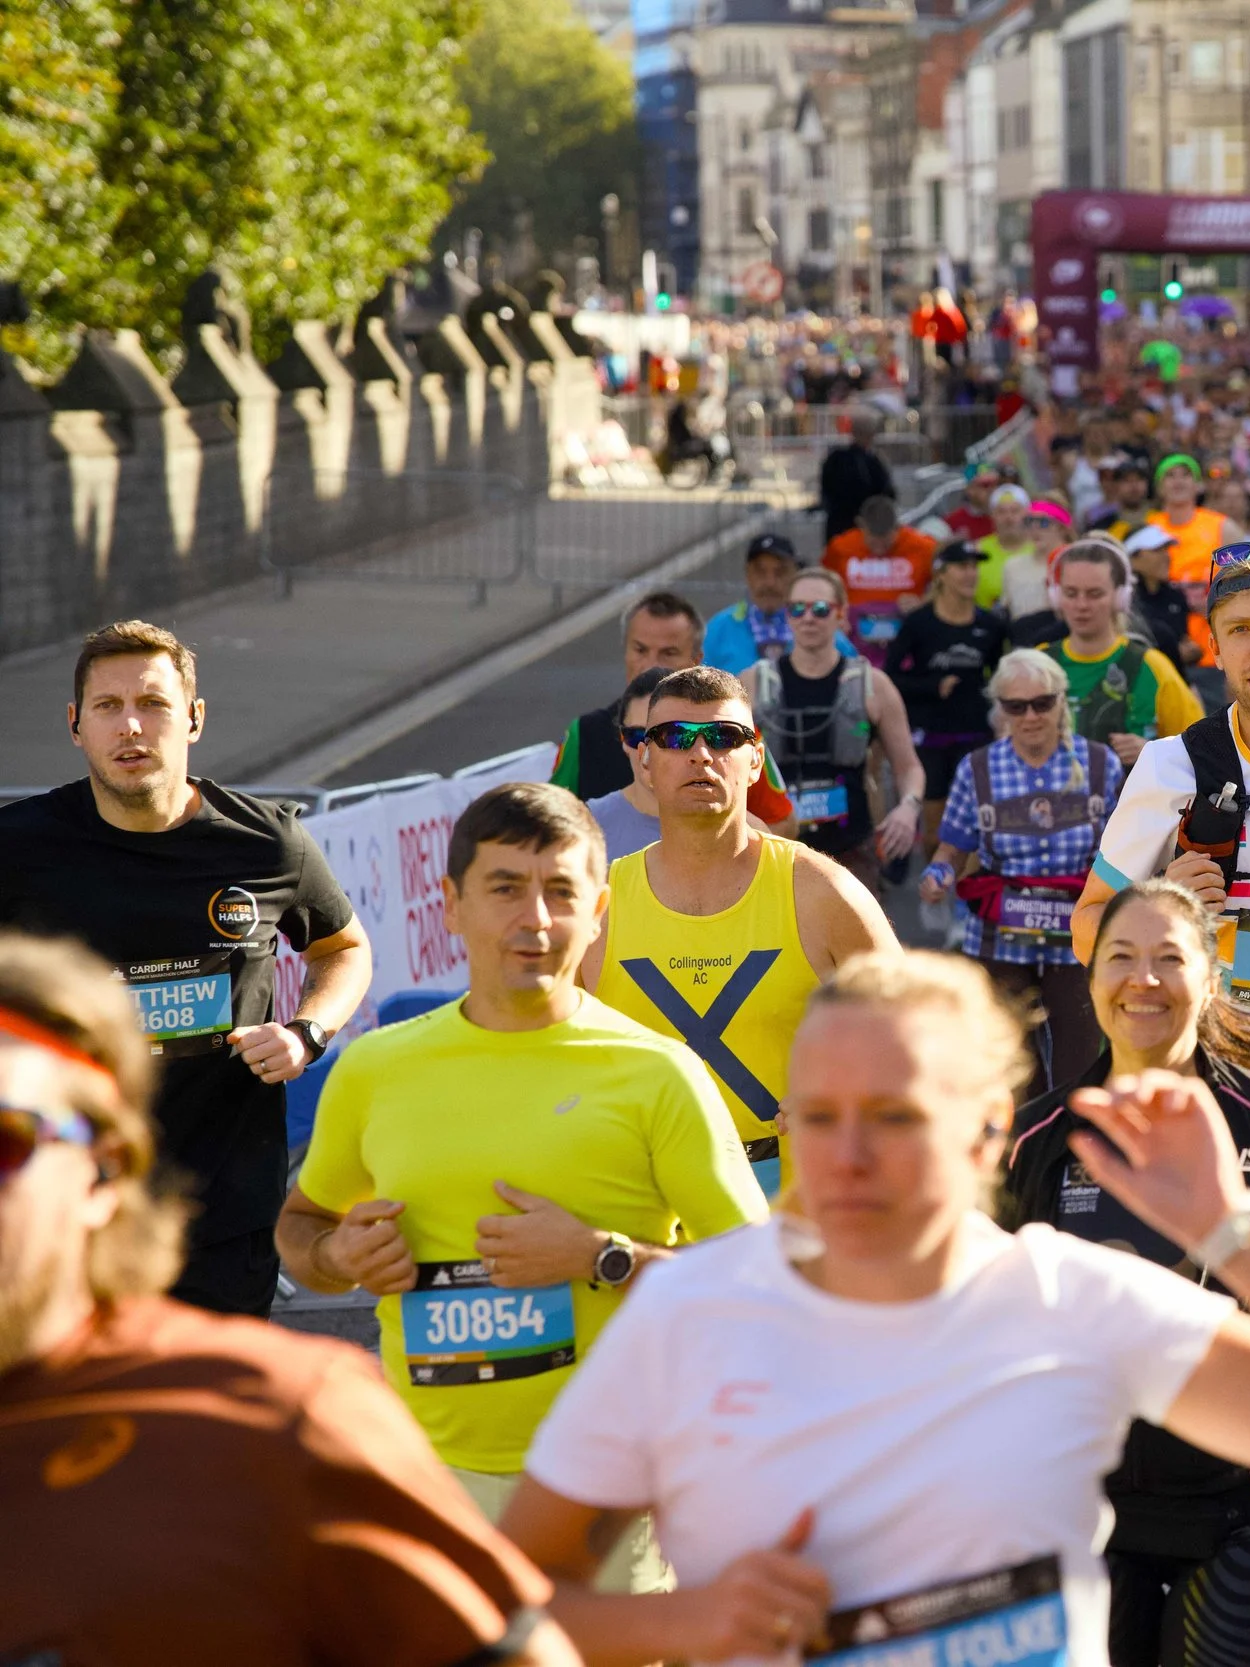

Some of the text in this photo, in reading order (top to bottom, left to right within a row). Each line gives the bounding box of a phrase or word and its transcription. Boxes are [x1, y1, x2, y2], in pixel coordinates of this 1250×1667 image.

[219, 903, 251, 913] SUPER
[218, 913, 253, 921] HALFS
[1024, 914, 1061, 929] 6724
[130, 959, 200, 975] CARDIFF HALF
[669, 954, 732, 970] Collingwood
[693, 972, 708, 985] AC
[197, 1026, 215, 1034] LARGE
[425, 1295, 545, 1345] 30854
